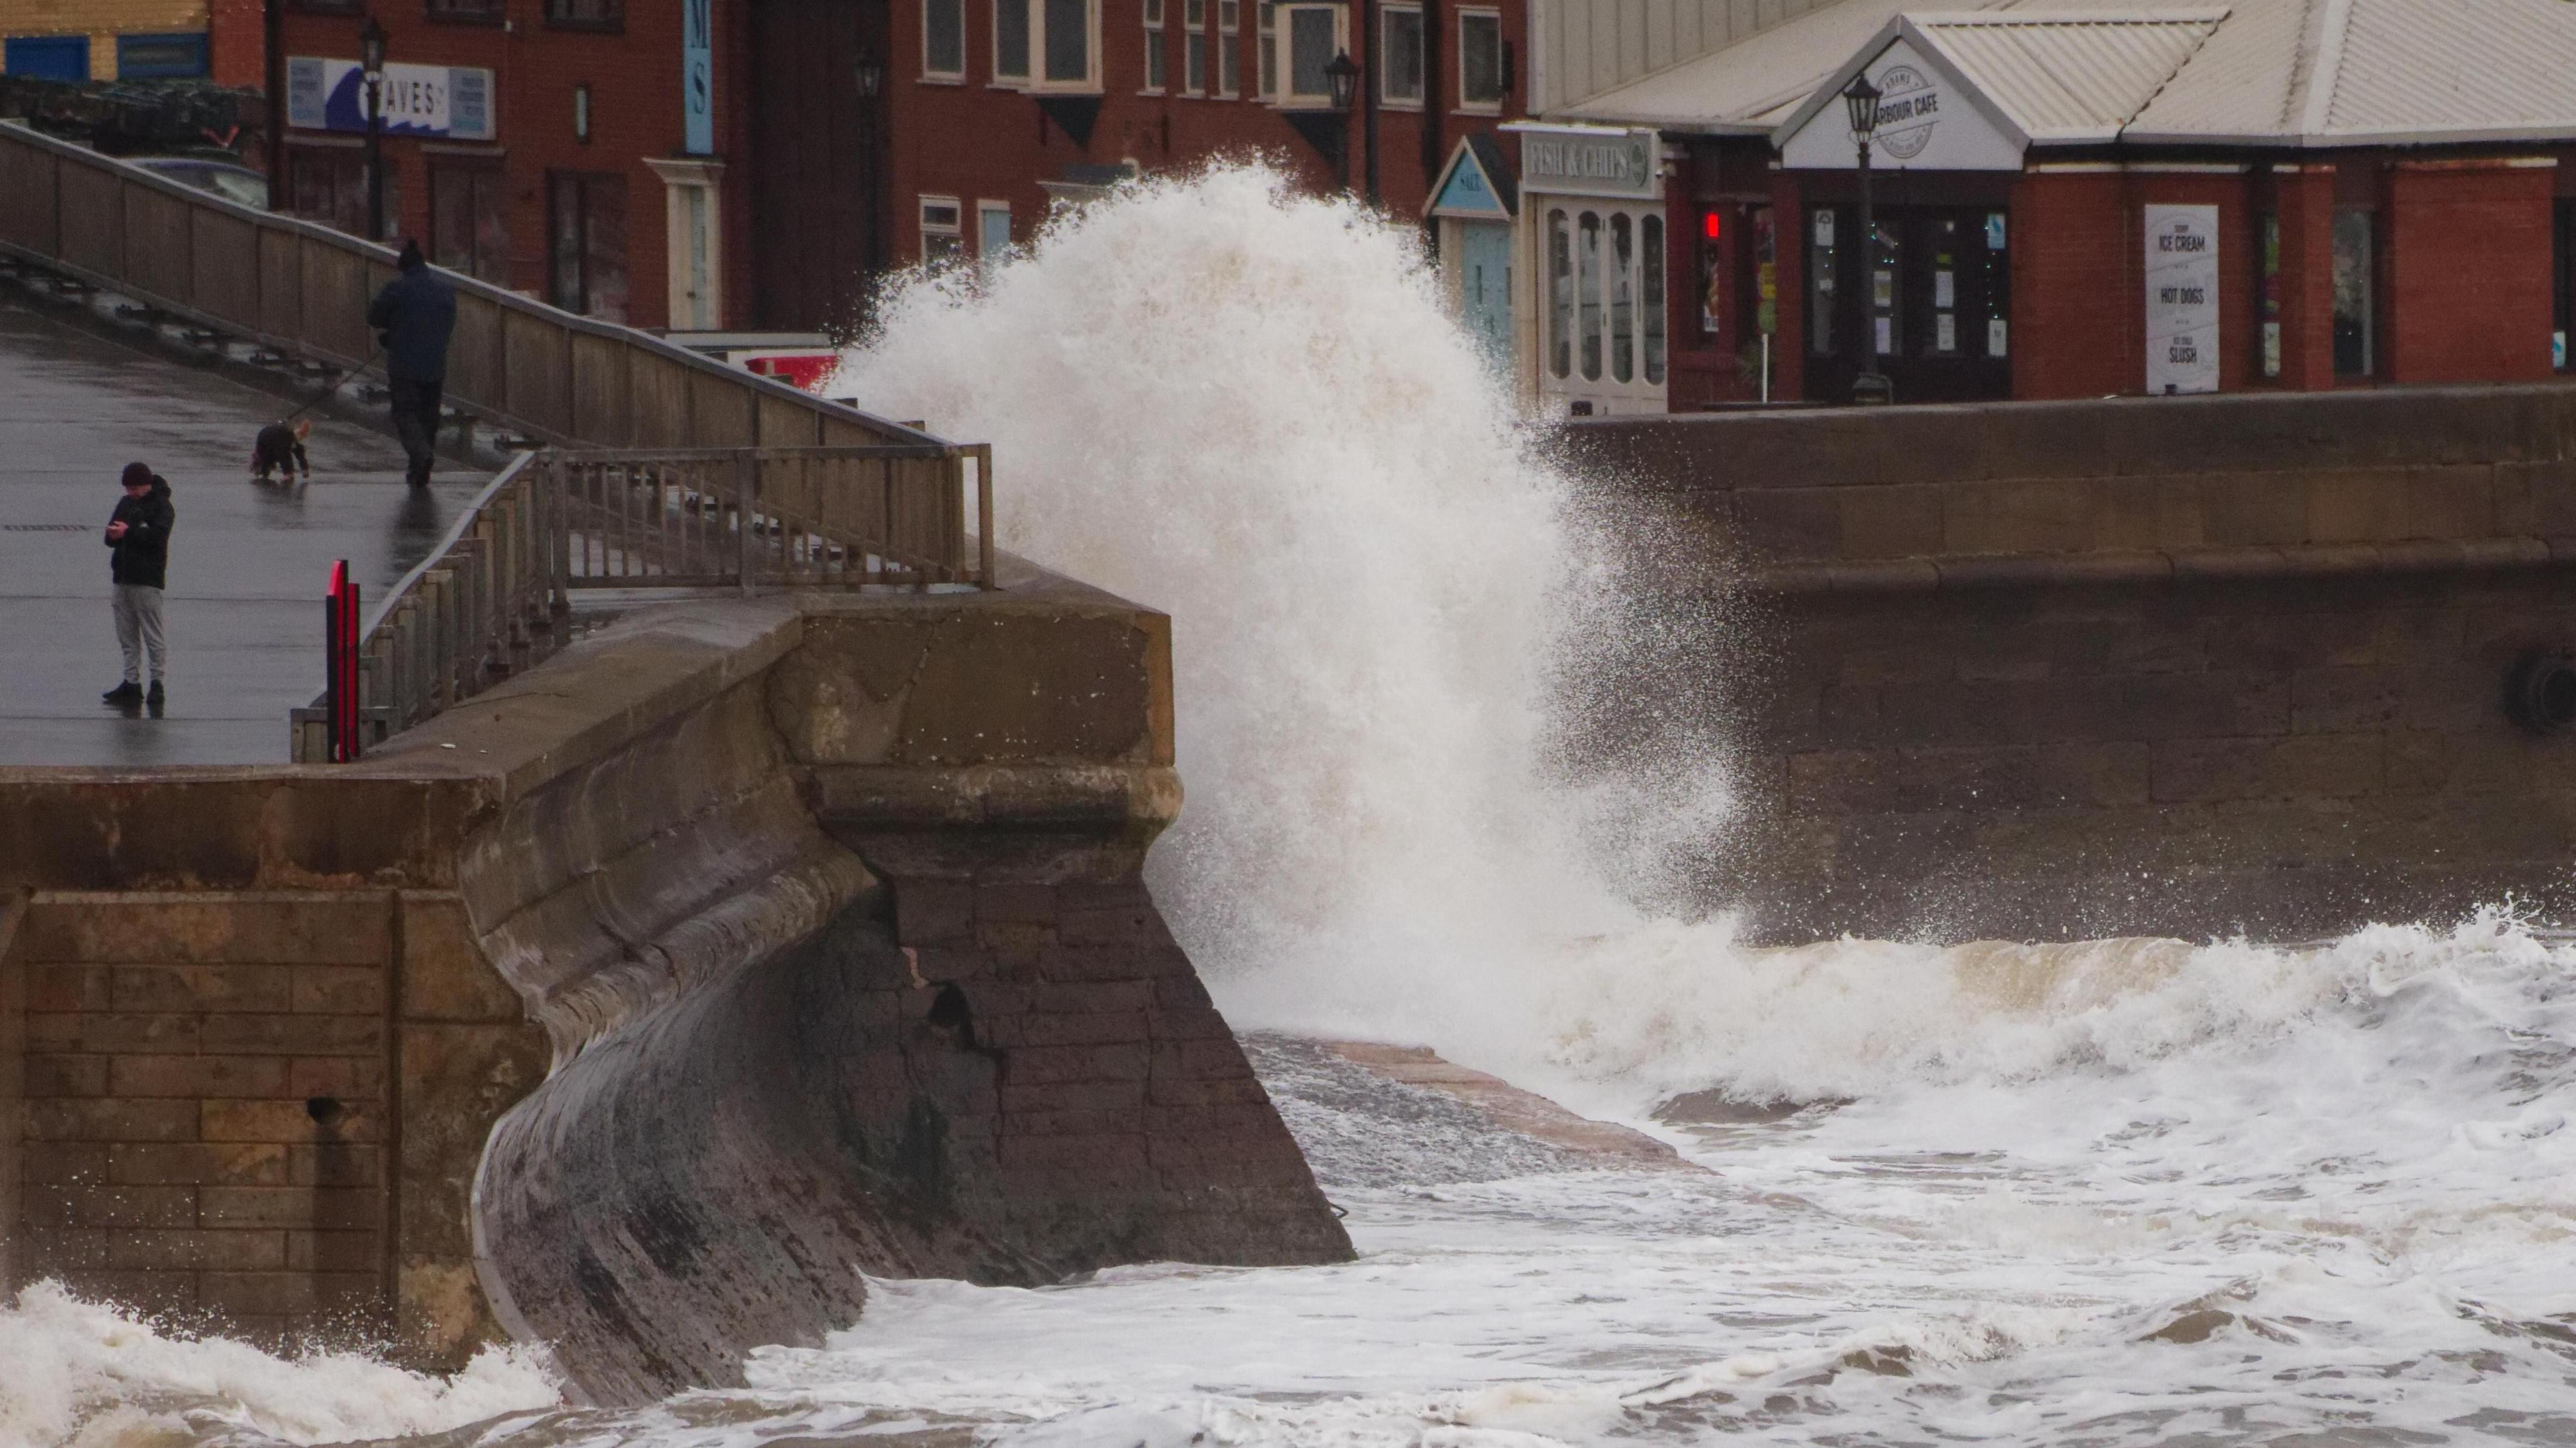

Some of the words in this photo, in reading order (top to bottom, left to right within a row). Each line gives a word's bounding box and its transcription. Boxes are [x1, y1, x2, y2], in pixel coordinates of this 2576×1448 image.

[378, 78, 435, 115] AVES
[1874, 100, 1913, 126] RBOUR
[1915, 93, 1939, 117] CAFE
[1531, 143, 1565, 176] FISH
[1567, 144, 1581, 176] &
[1584, 145, 1628, 178] CHIPS
[2159, 235, 2173, 252] ICE
[2175, 235, 2206, 253] CREAM
[2161, 288, 2178, 304] HOT
[2180, 288, 2204, 305] DOGS
[2169, 346, 2198, 364] SLUSH
